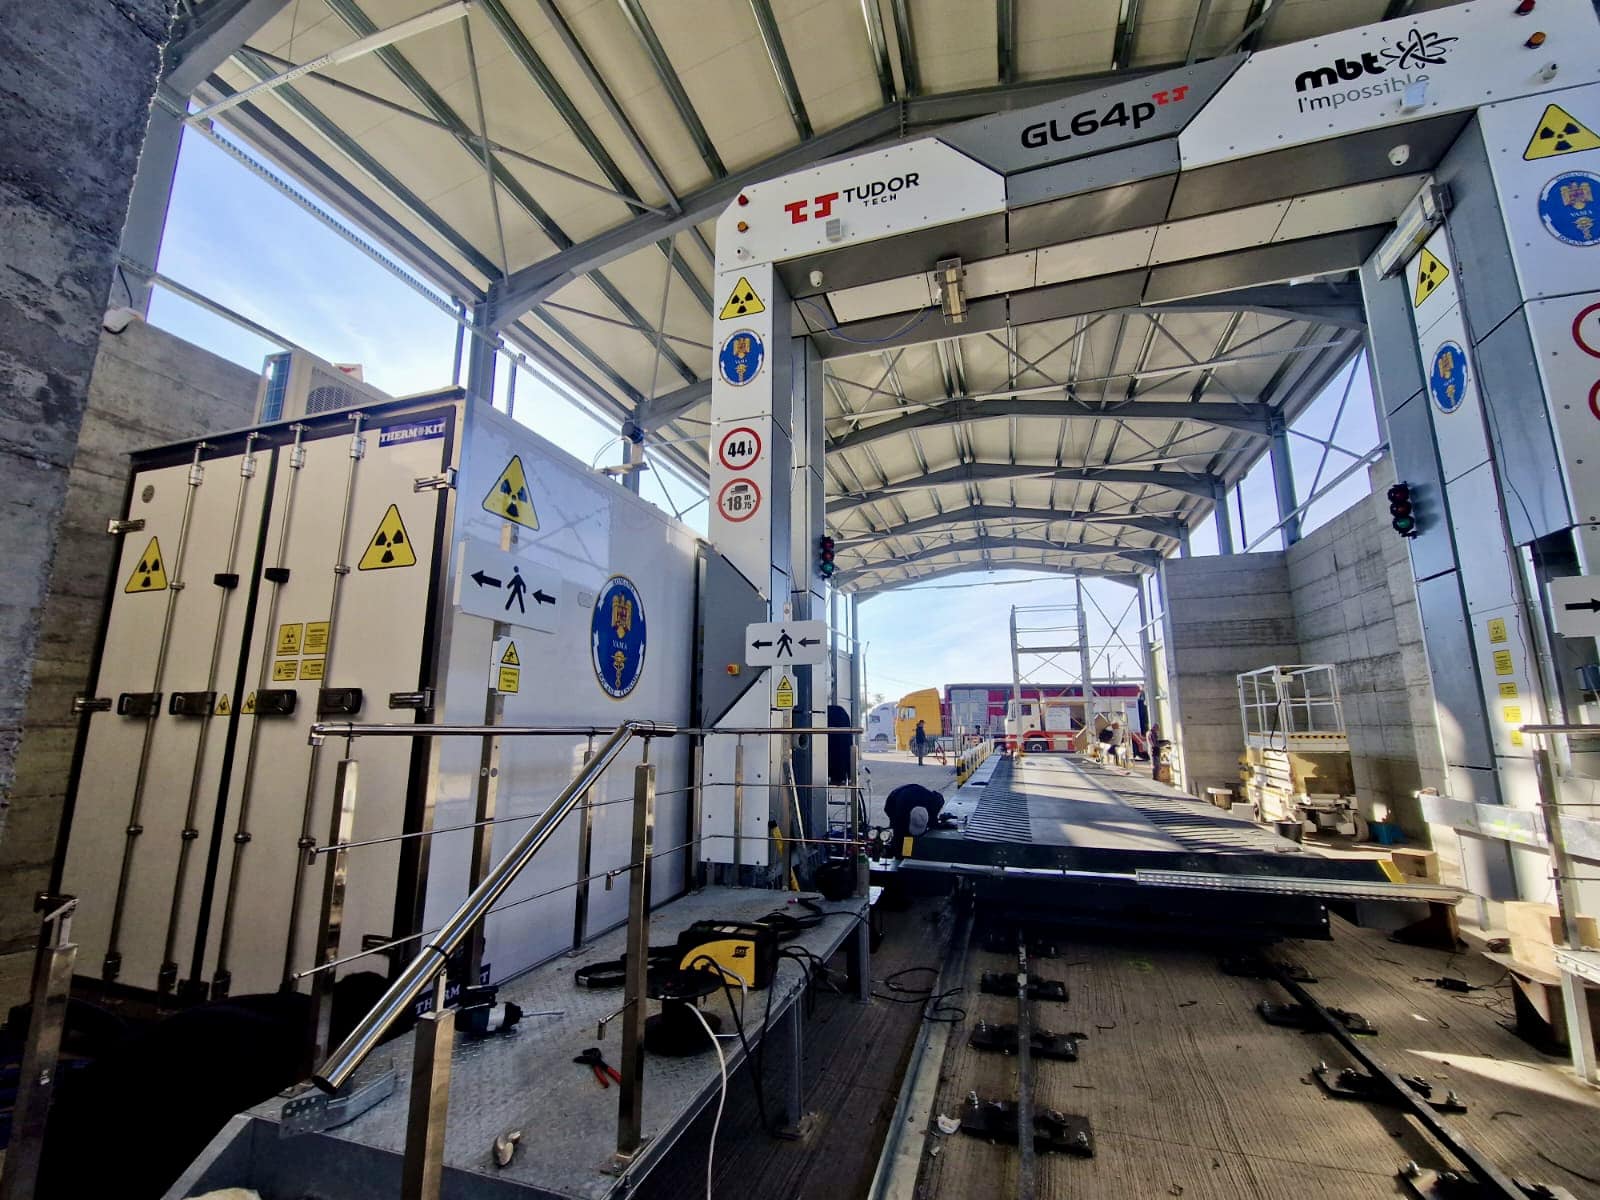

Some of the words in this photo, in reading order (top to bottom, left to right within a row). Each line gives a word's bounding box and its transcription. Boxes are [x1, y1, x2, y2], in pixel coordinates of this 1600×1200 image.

[1295, 52, 1387, 92] mbt
[1021, 102, 1155, 149] GL64p
[842, 172, 920, 203] TUDOR
[863, 193, 897, 207] TECH
[727, 441, 746, 457] 44
[727, 495, 742, 511] 18
